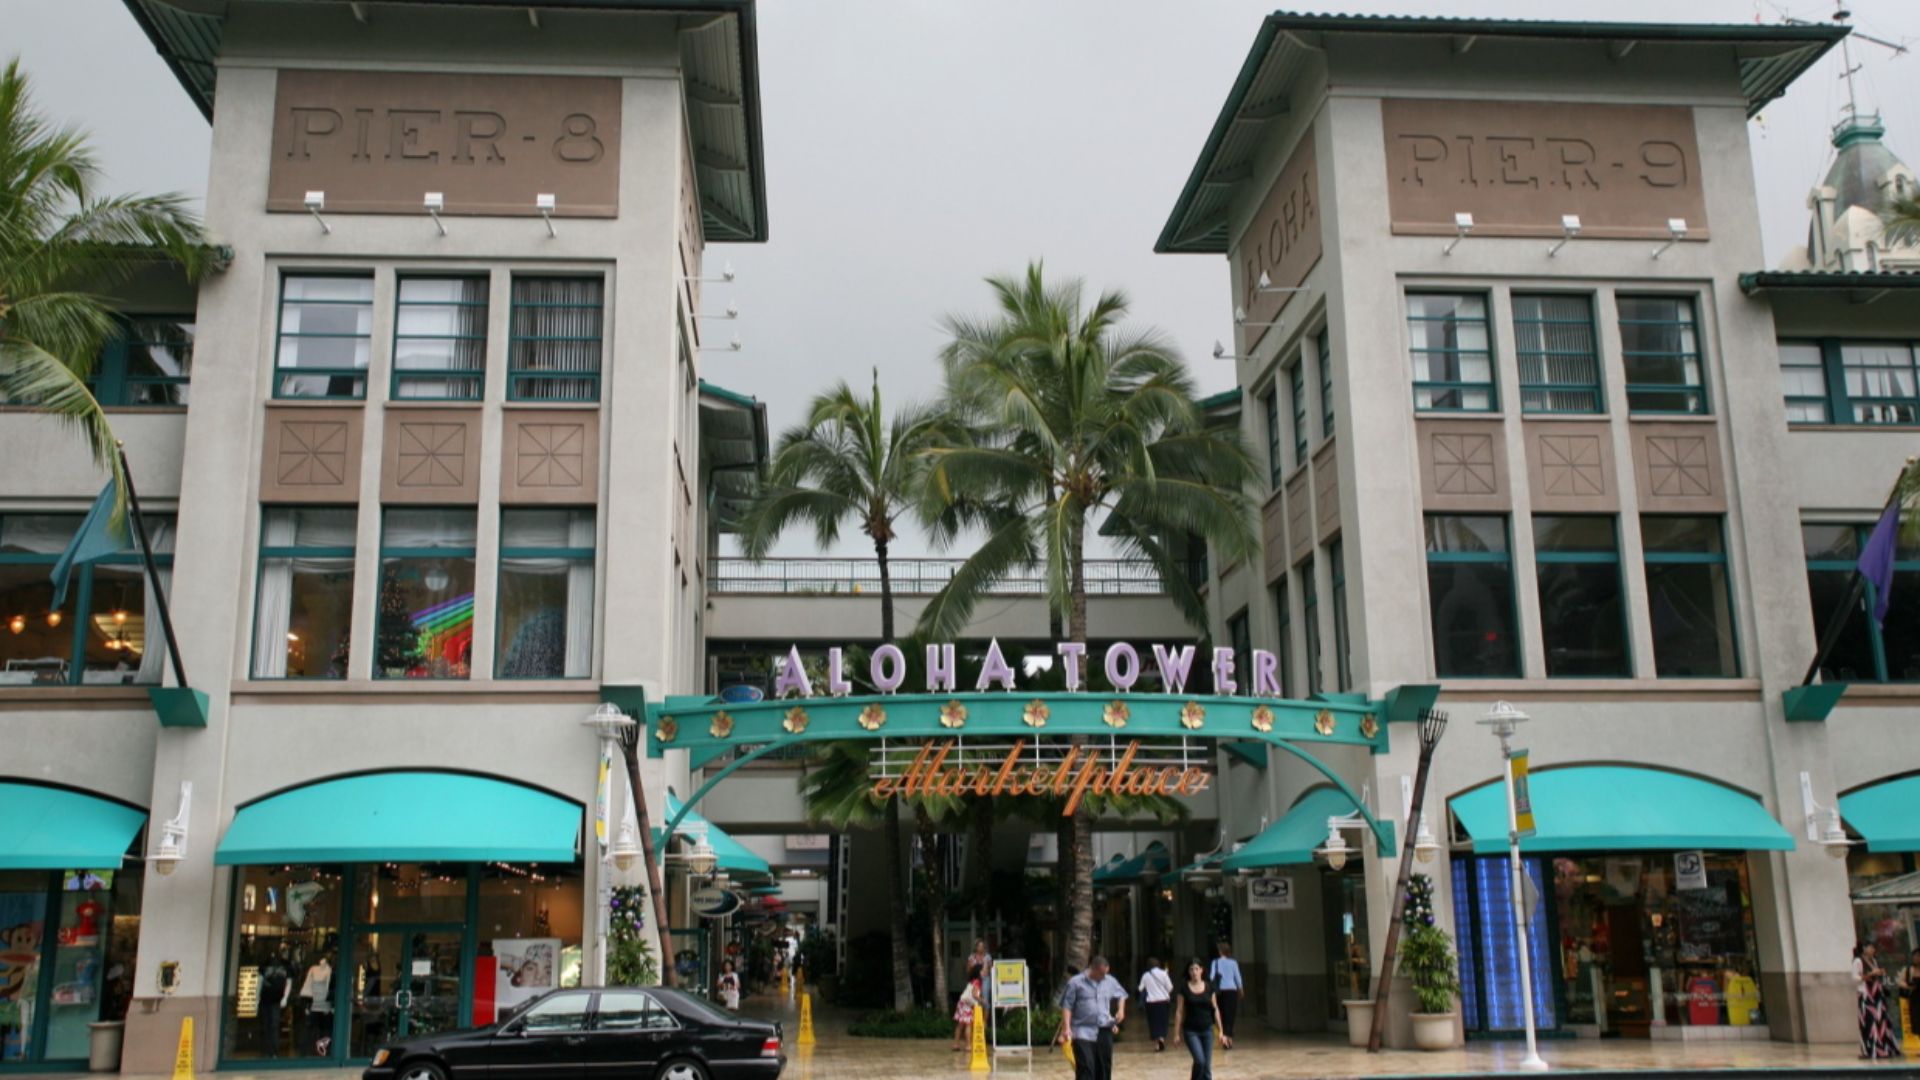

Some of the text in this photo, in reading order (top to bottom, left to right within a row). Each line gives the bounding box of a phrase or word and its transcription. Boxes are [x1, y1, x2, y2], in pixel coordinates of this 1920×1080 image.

[1245, 170, 1314, 313] ALOHA
[775, 635, 1282, 698] ALOHA TOWER
[872, 738, 1212, 818] Marketplace
